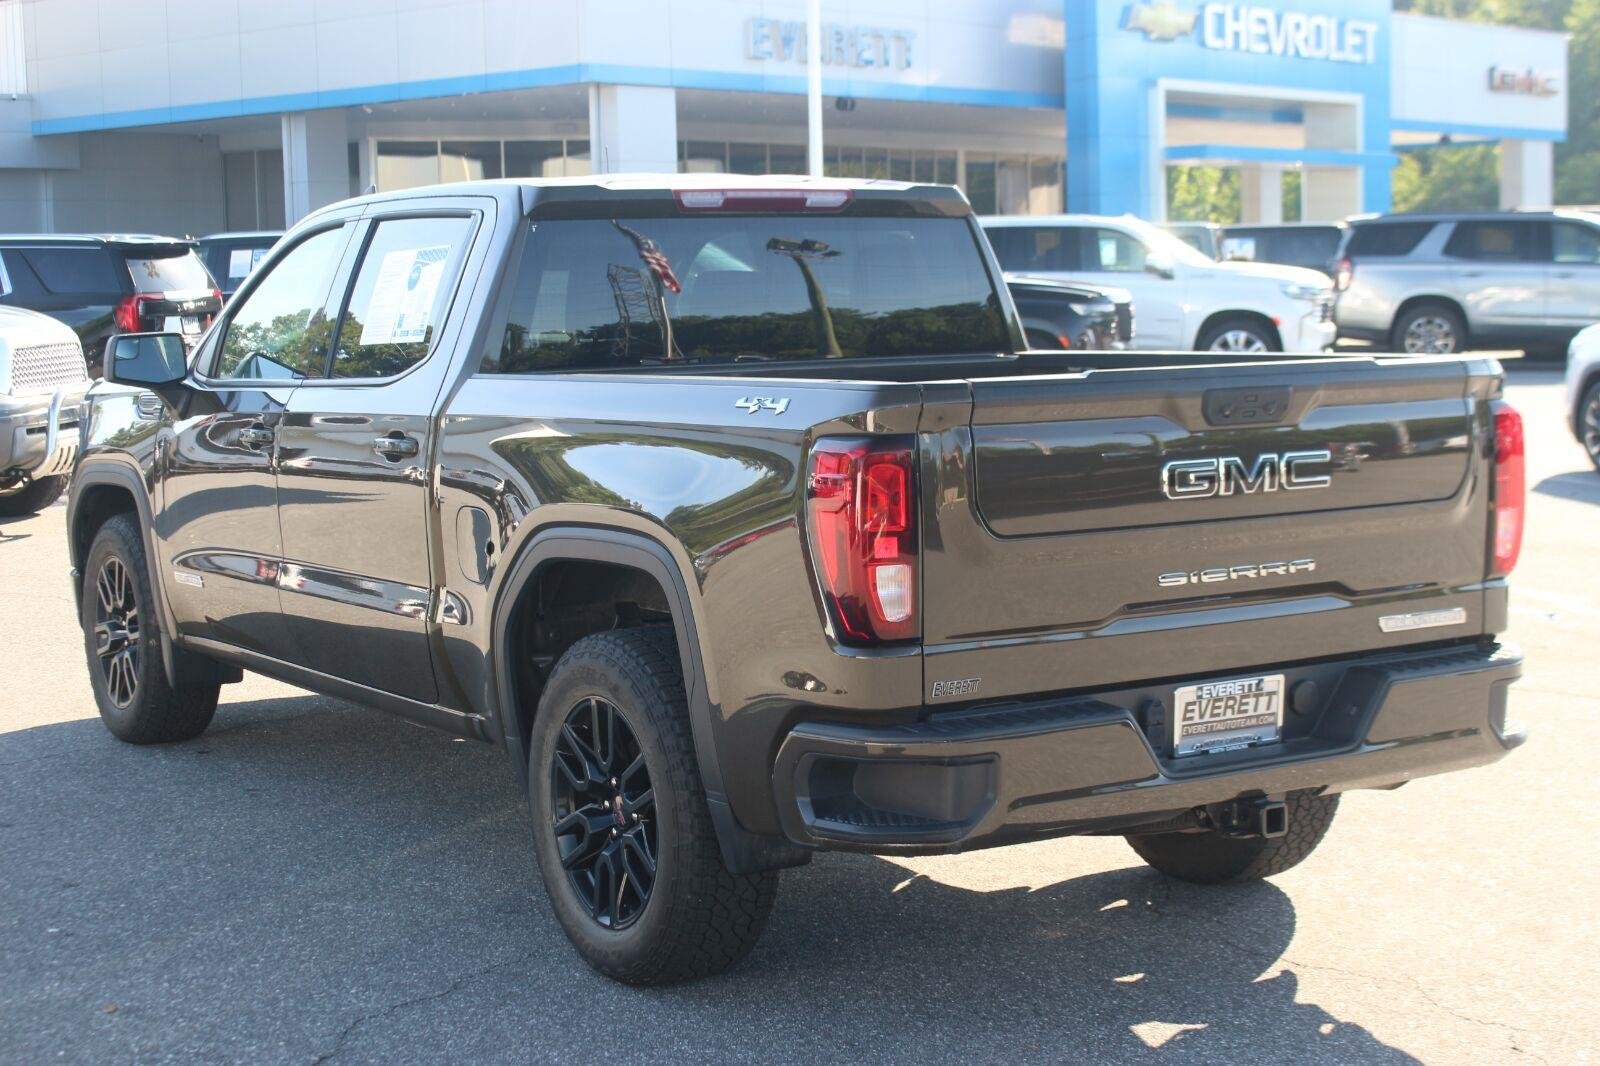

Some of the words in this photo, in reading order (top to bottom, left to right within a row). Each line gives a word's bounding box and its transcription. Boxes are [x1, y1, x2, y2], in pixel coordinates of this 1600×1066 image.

[1203, 4, 1379, 64] CHEVROLET
[1162, 449, 1332, 500] GMC
[1157, 557, 1317, 588] SIERRA
[932, 677, 982, 698] EVERETT
[1202, 680, 1259, 699] EVERETT
[1182, 690, 1278, 722] EVERETT
